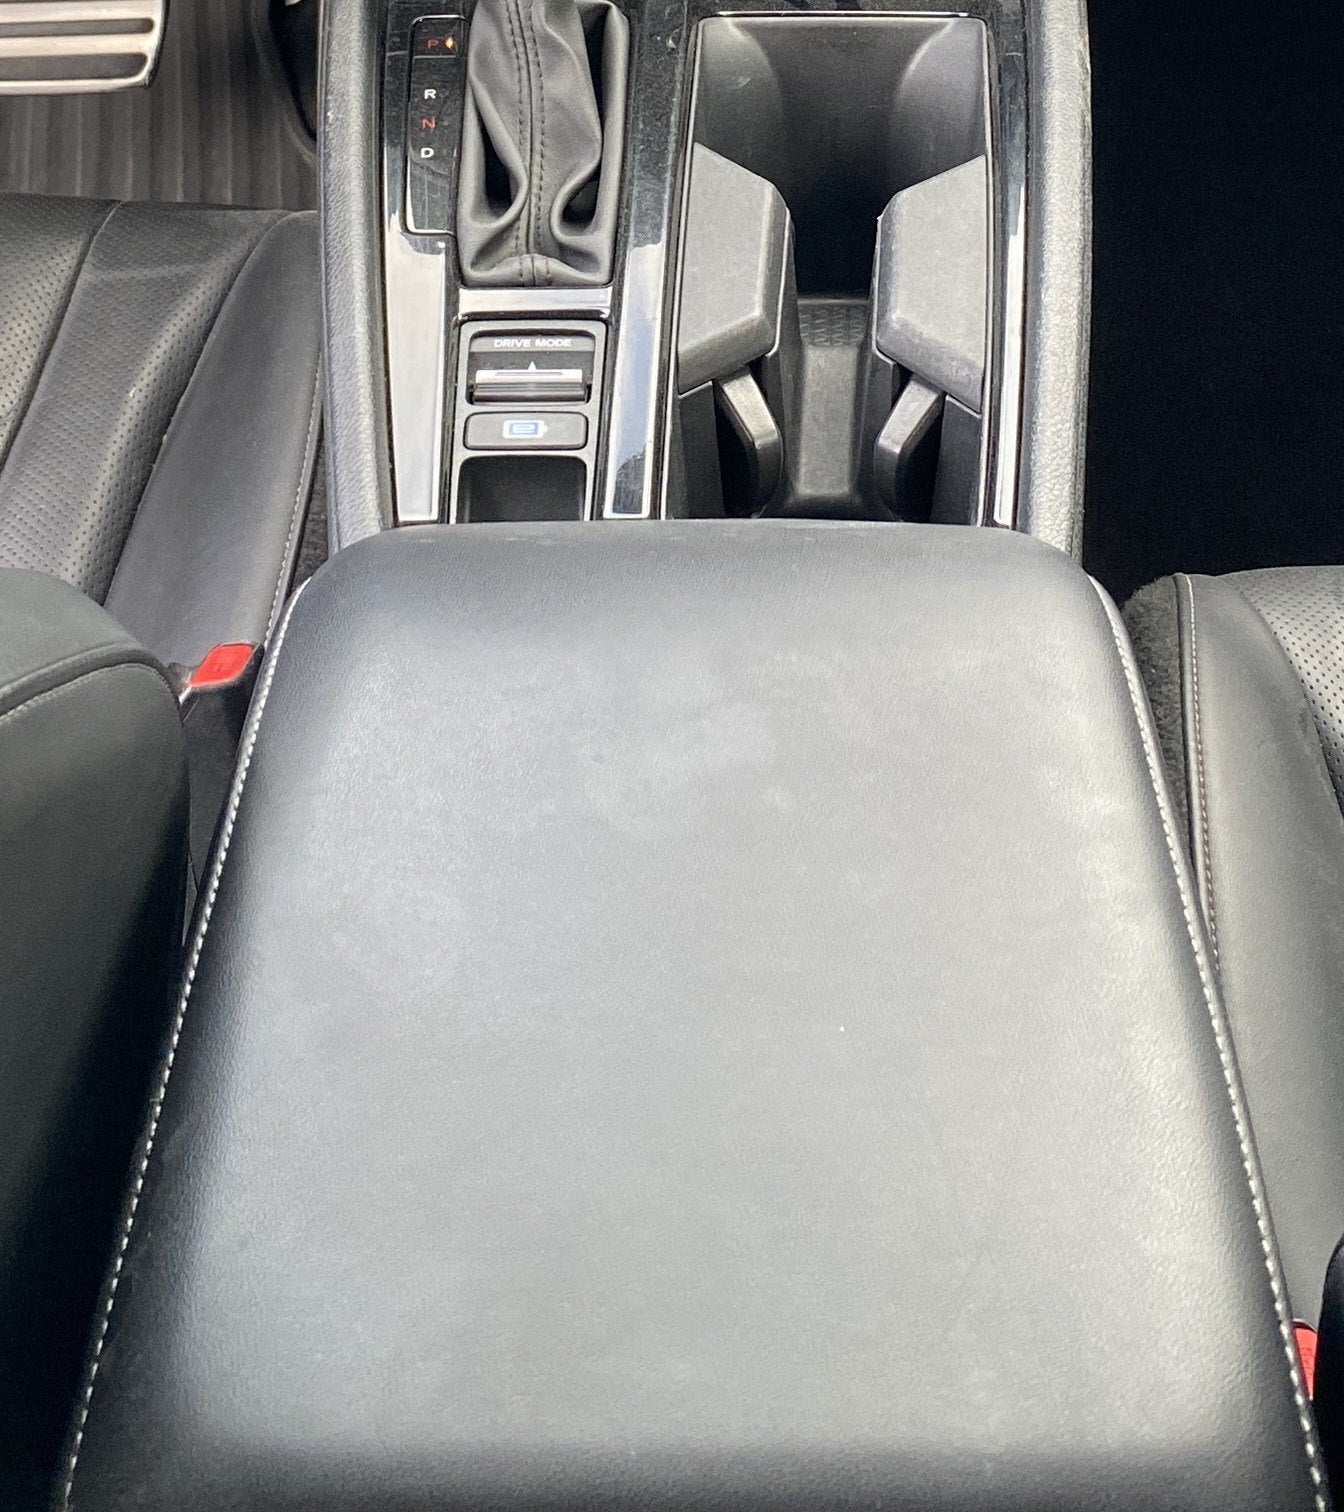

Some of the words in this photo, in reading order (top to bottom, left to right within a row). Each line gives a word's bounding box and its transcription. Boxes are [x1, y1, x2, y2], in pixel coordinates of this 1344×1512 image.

[427, 39, 439, 49] P
[424, 88, 437, 100] R
[422, 118, 436, 130] N
[421, 147, 435, 158] D
[493, 338, 531, 348] DRIVE
[534, 338, 573, 348] MODE
